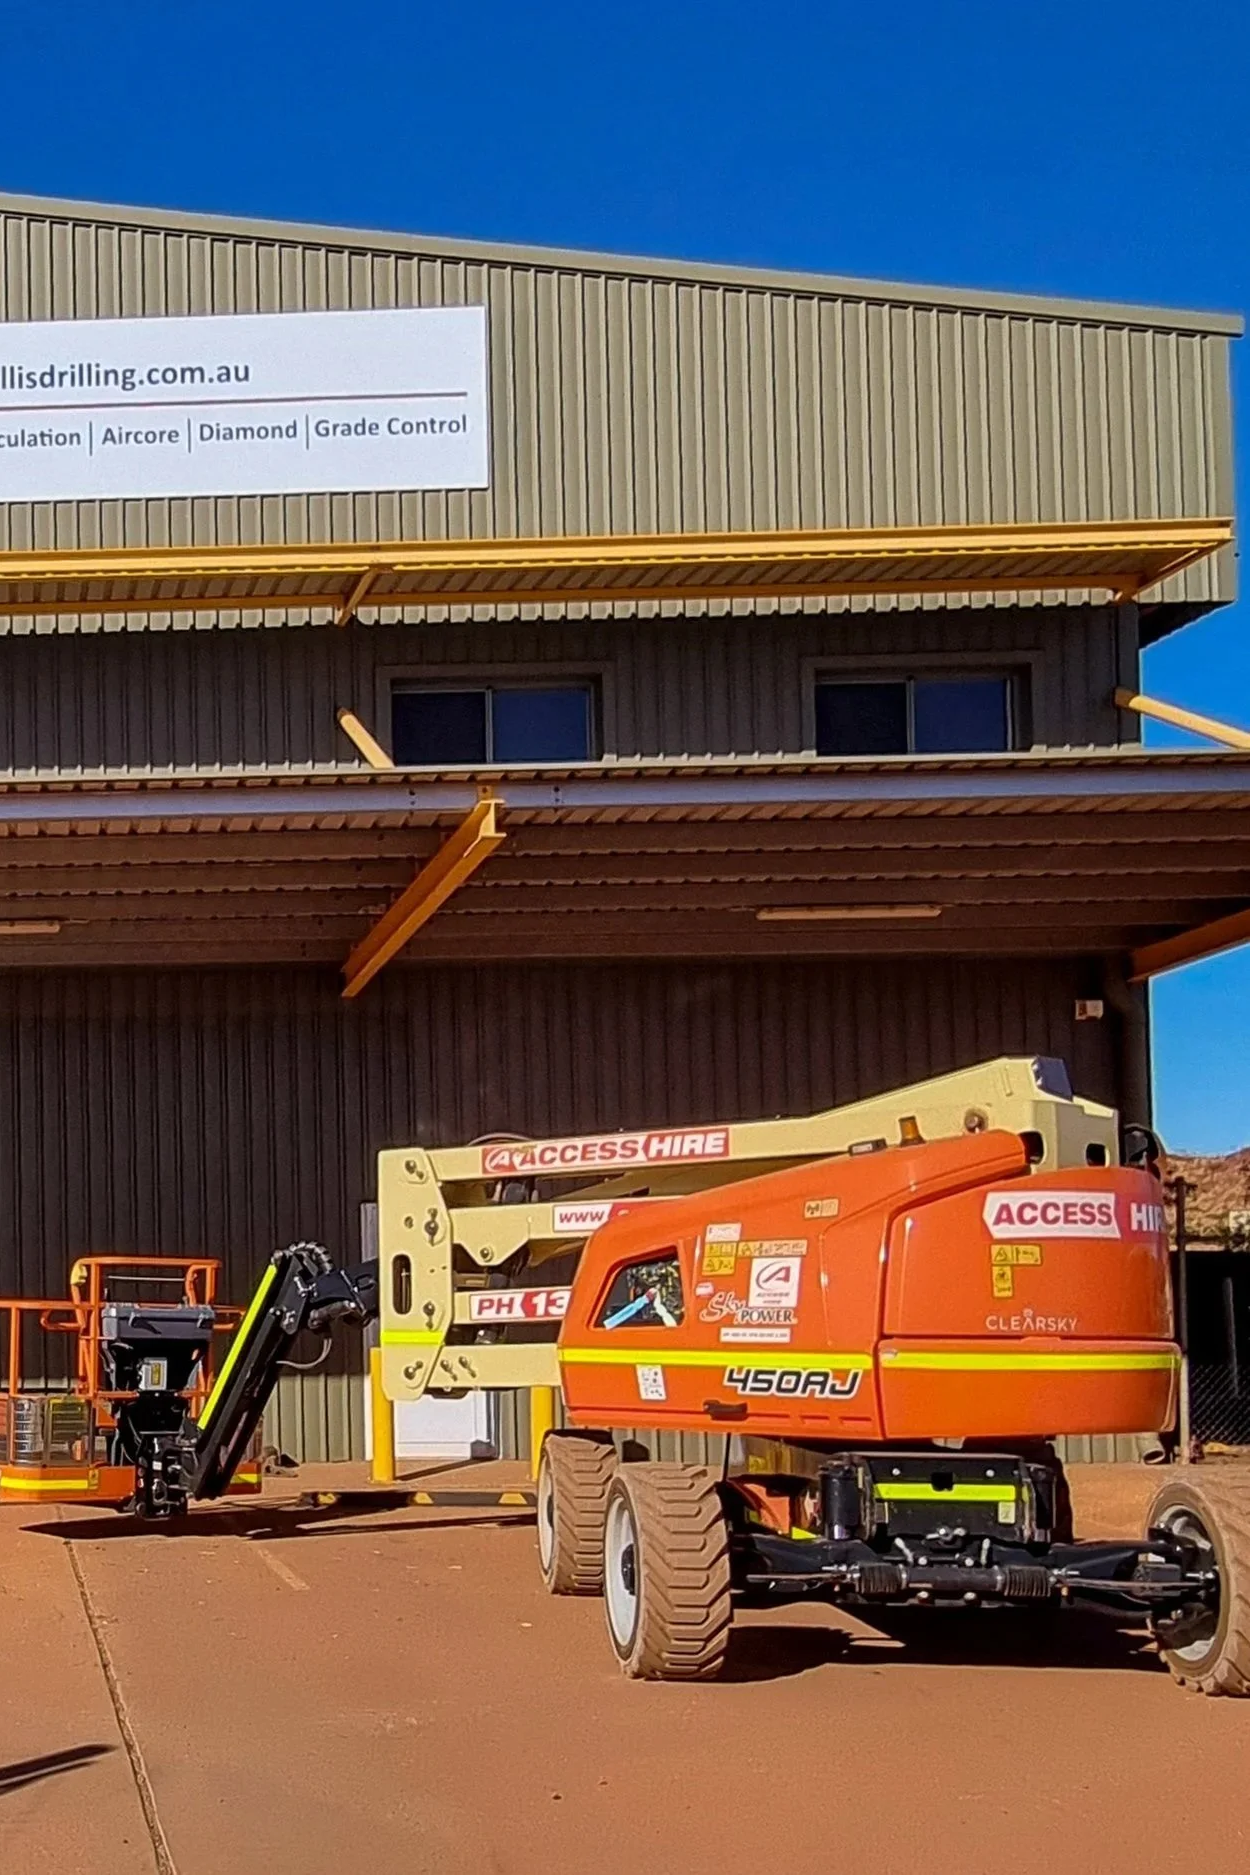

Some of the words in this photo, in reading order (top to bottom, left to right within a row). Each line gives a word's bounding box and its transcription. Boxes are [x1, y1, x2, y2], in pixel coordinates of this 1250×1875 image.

[102, 426, 180, 446] Aircore
[199, 419, 298, 442] Diamond
[314, 417, 380, 437] Grade
[386, 414, 468, 436] Control
[519, 1139, 640, 1167] ACCESS
[647, 1132, 727, 1158] HIRE
[992, 1201, 1114, 1227] ACCESS
[477, 1296, 515, 1316] PH
[739, 1309, 793, 1323] POWER
[985, 1312, 1078, 1332] CLEARSKY
[726, 1367, 860, 1396] 450AJ
